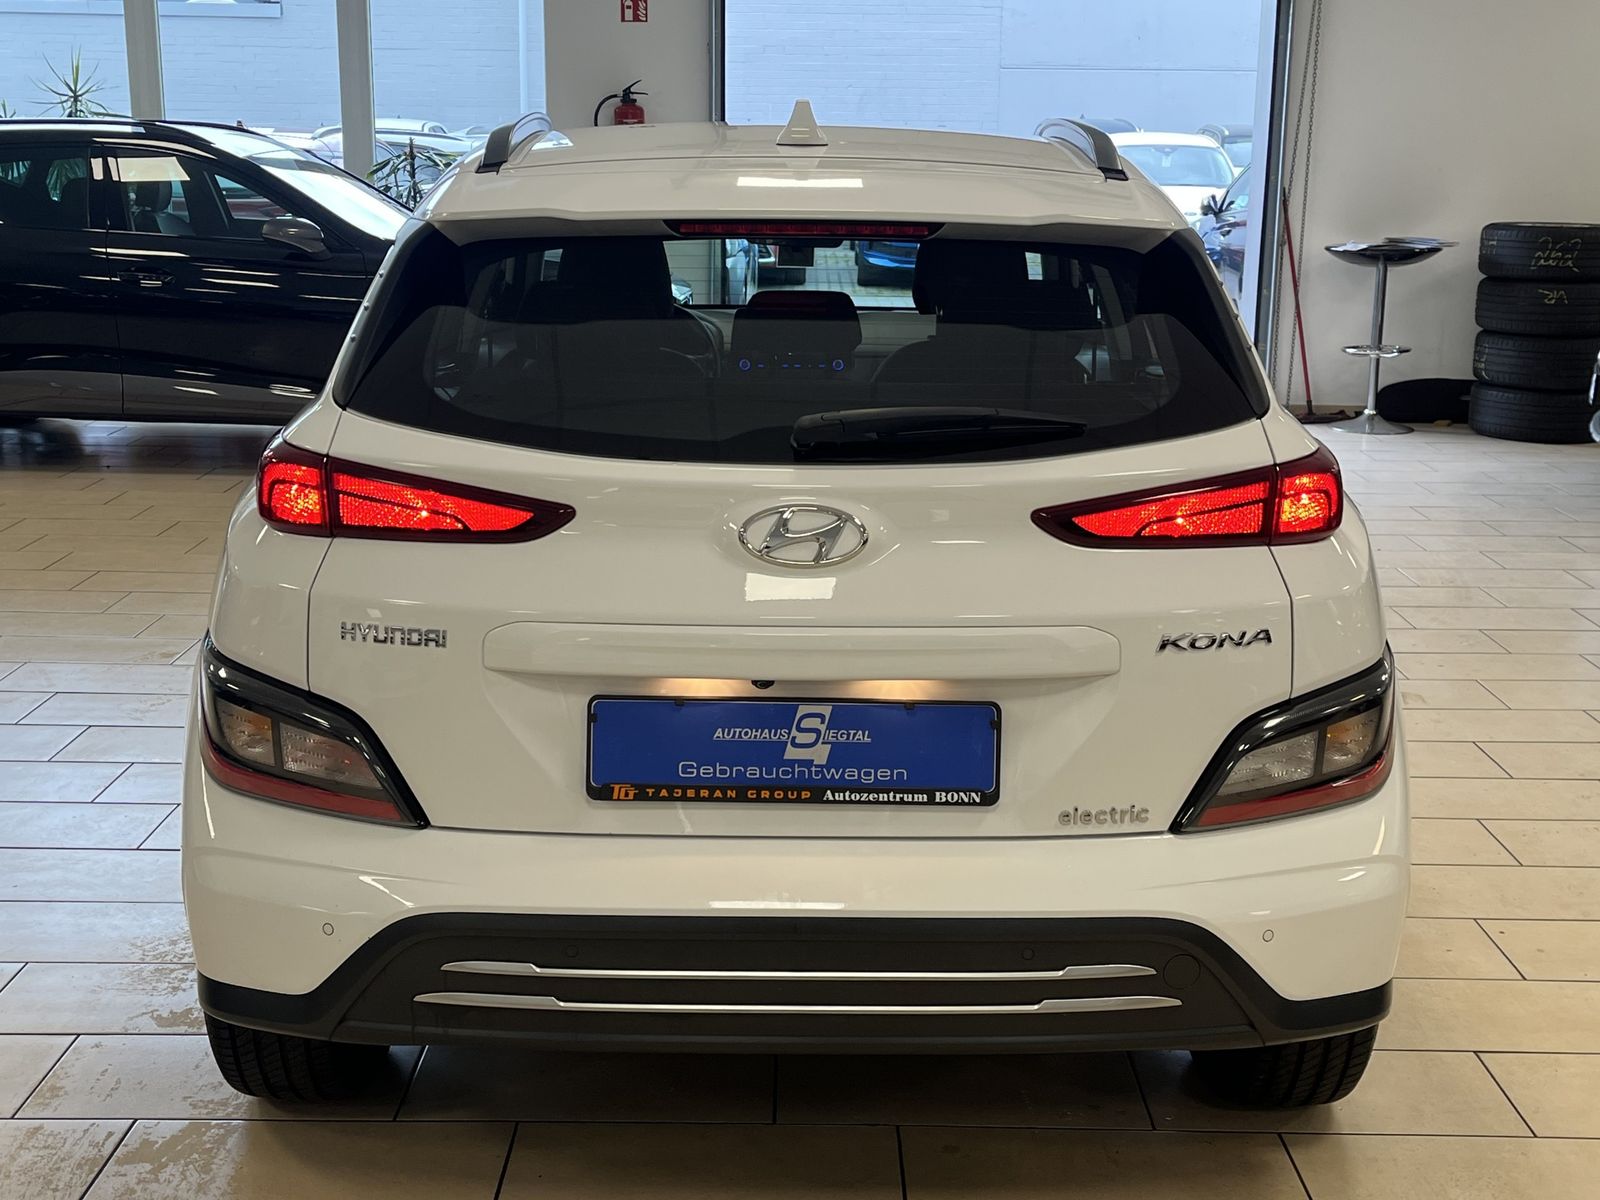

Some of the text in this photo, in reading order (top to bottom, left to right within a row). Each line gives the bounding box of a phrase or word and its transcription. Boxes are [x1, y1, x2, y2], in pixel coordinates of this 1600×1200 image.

[340, 621, 447, 648] HYUNDAI
[1156, 629, 1272, 652] KONA
[713, 727, 789, 741] AUTOHAUS
[678, 761, 908, 784] Gebrauchtwagen
[646, 788, 737, 799] TAJERAN
[747, 789, 811, 800] GROUP
[822, 789, 982, 803] Autozentrum BONN
[1058, 804, 1150, 826] electric
